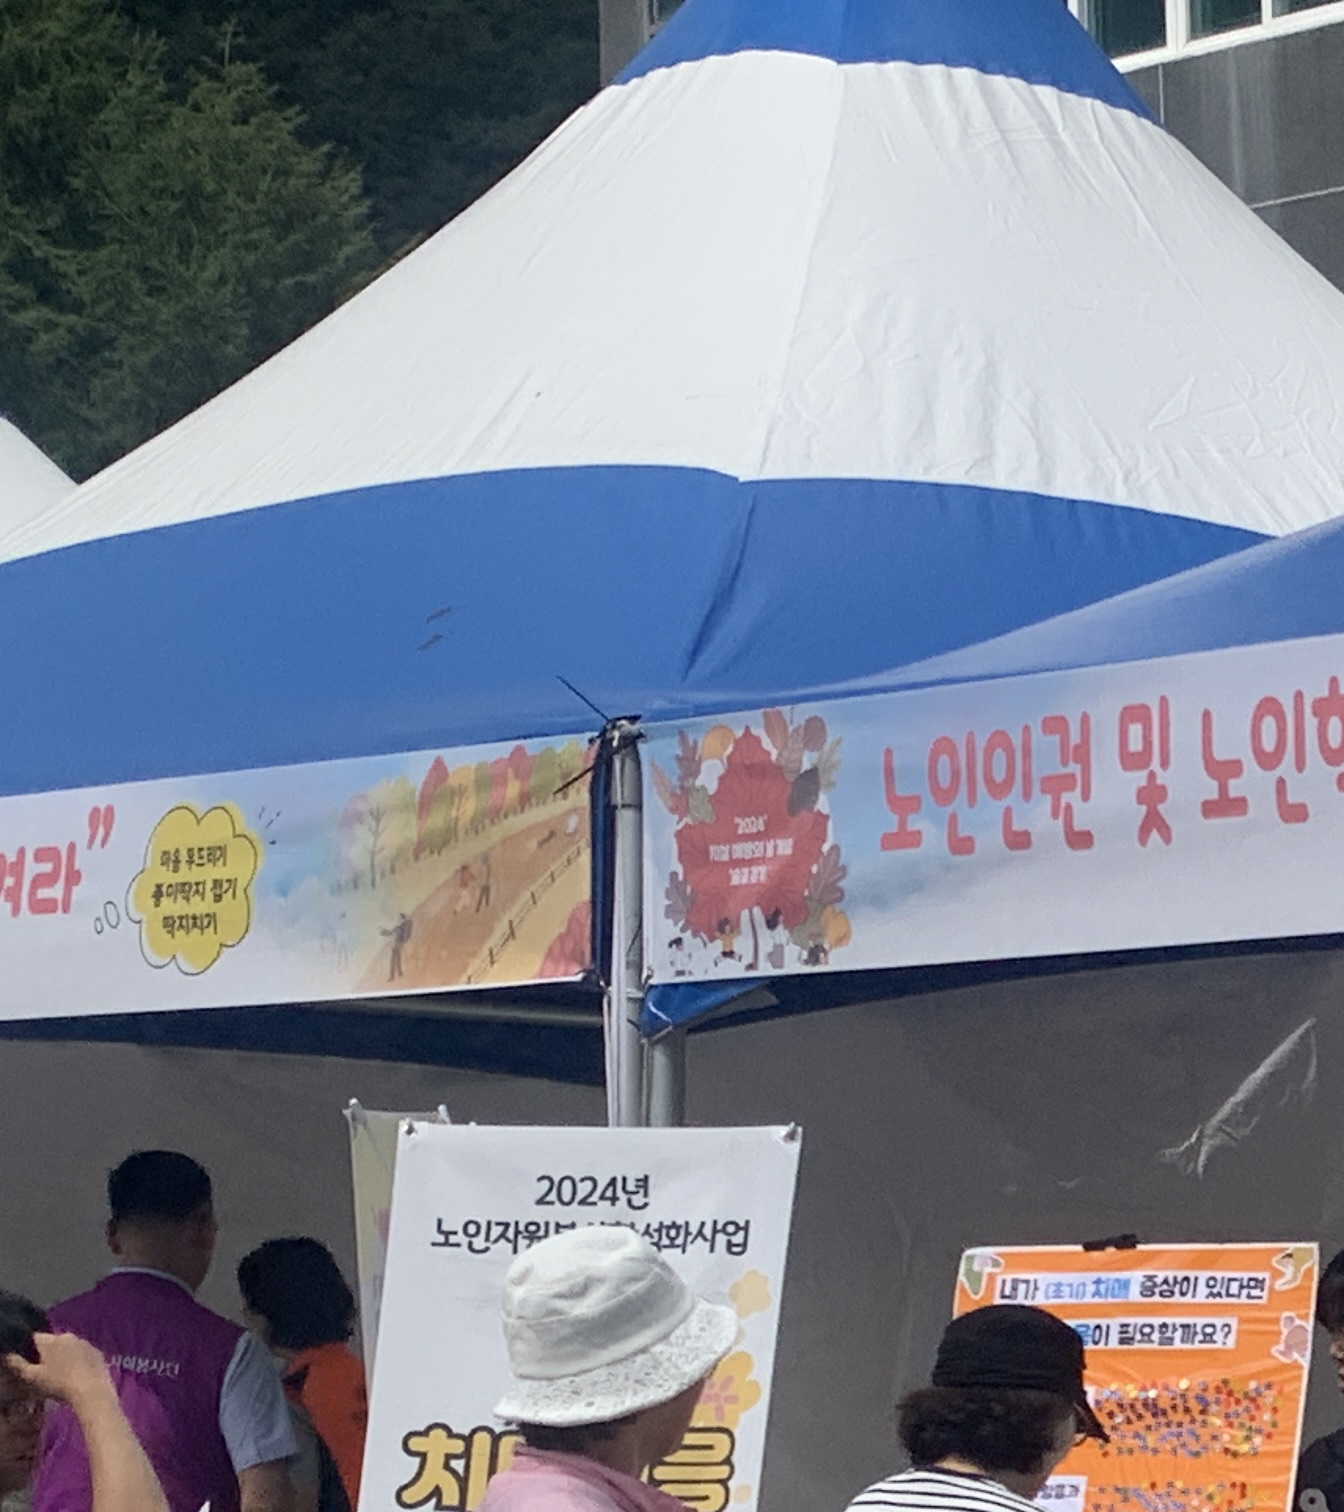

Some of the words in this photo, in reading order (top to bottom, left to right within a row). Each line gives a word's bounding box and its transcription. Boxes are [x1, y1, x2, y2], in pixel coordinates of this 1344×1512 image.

[880, 711, 1096, 855] 노인인권
[1118, 695, 1174, 848] 및
[162, 912, 218, 939] 딱지치기
[535, 1174, 650, 1211] 2024년
[1000, 1278, 1039, 1300] 내가
[1138, 1275, 1198, 1299] 증상이
[1205, 1276, 1266, 1301] 있다면
[1117, 1322, 1232, 1347] 필요할까요?
